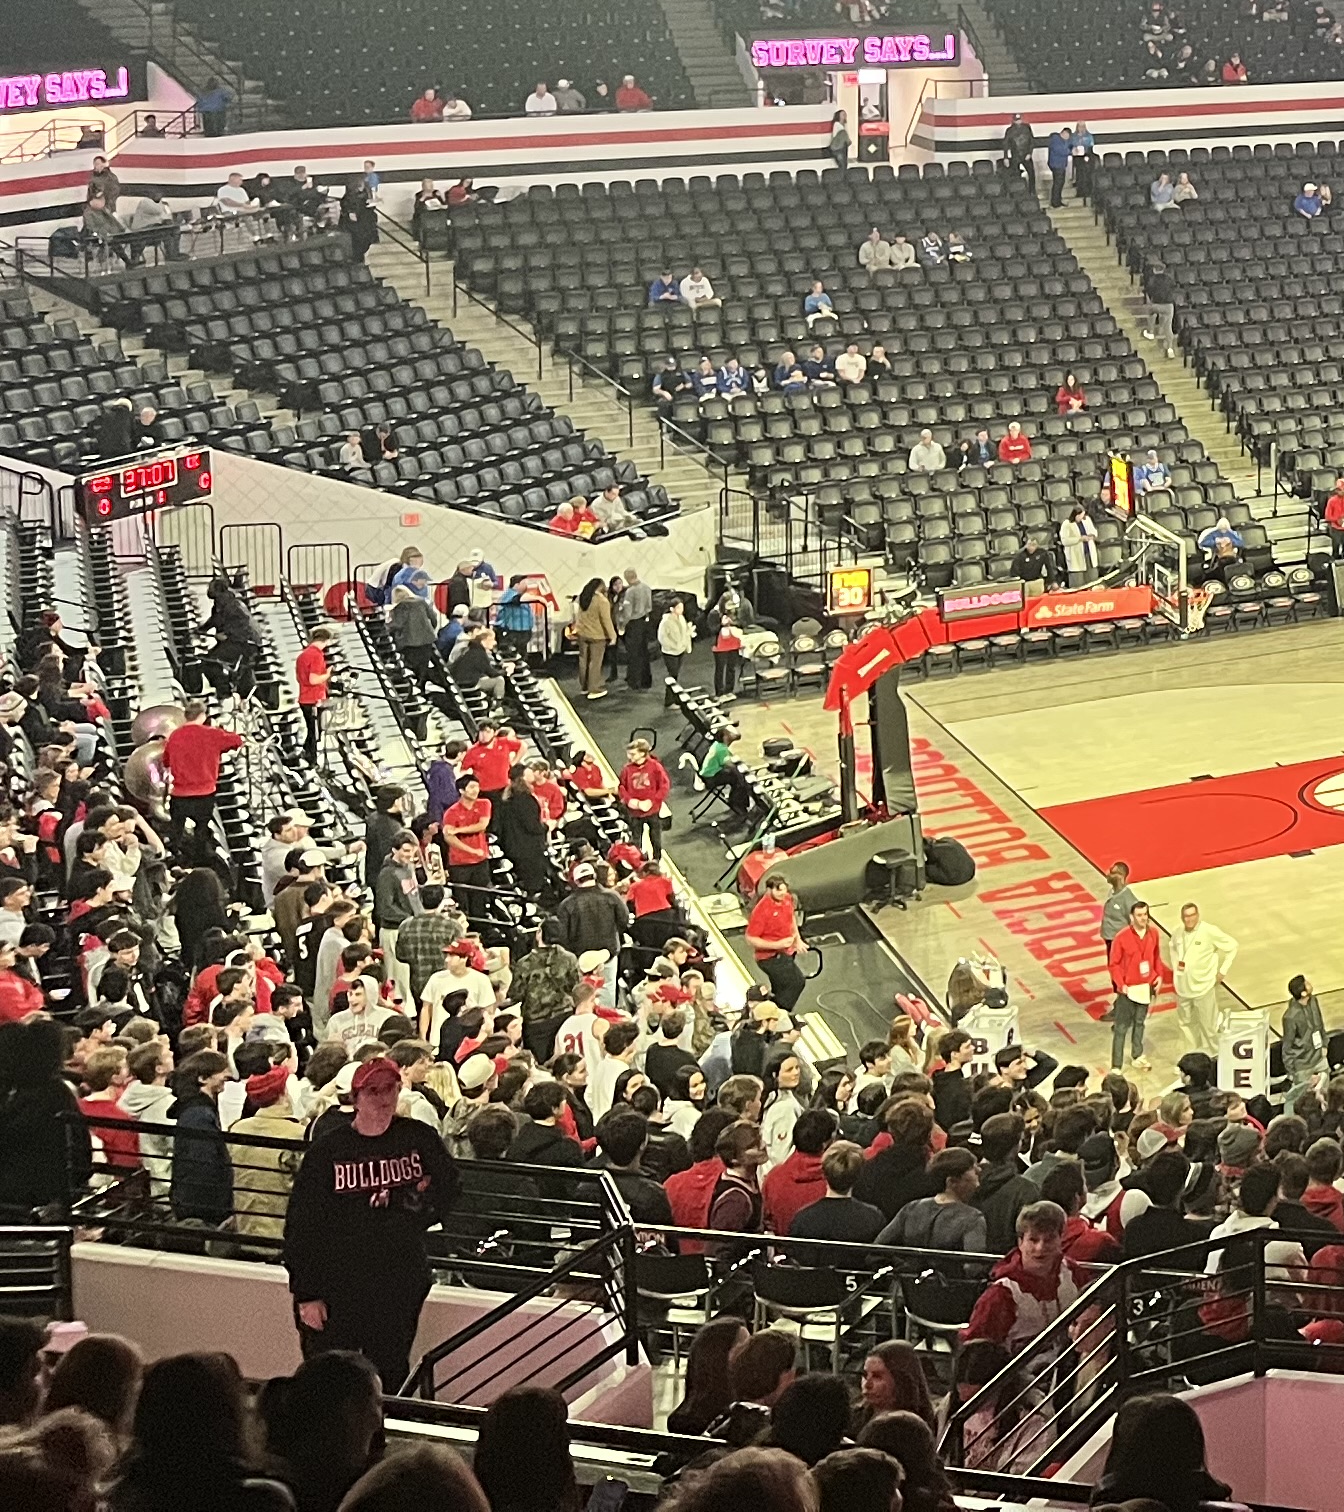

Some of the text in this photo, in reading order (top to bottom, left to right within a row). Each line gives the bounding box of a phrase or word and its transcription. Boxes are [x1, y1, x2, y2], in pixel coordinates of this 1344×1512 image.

[752, 37, 859, 67] SURVEY
[333, 1152, 425, 1191] BULLDOGS
[845, 1275, 857, 1292] 5
[1132, 1298, 1144, 1316] 3
